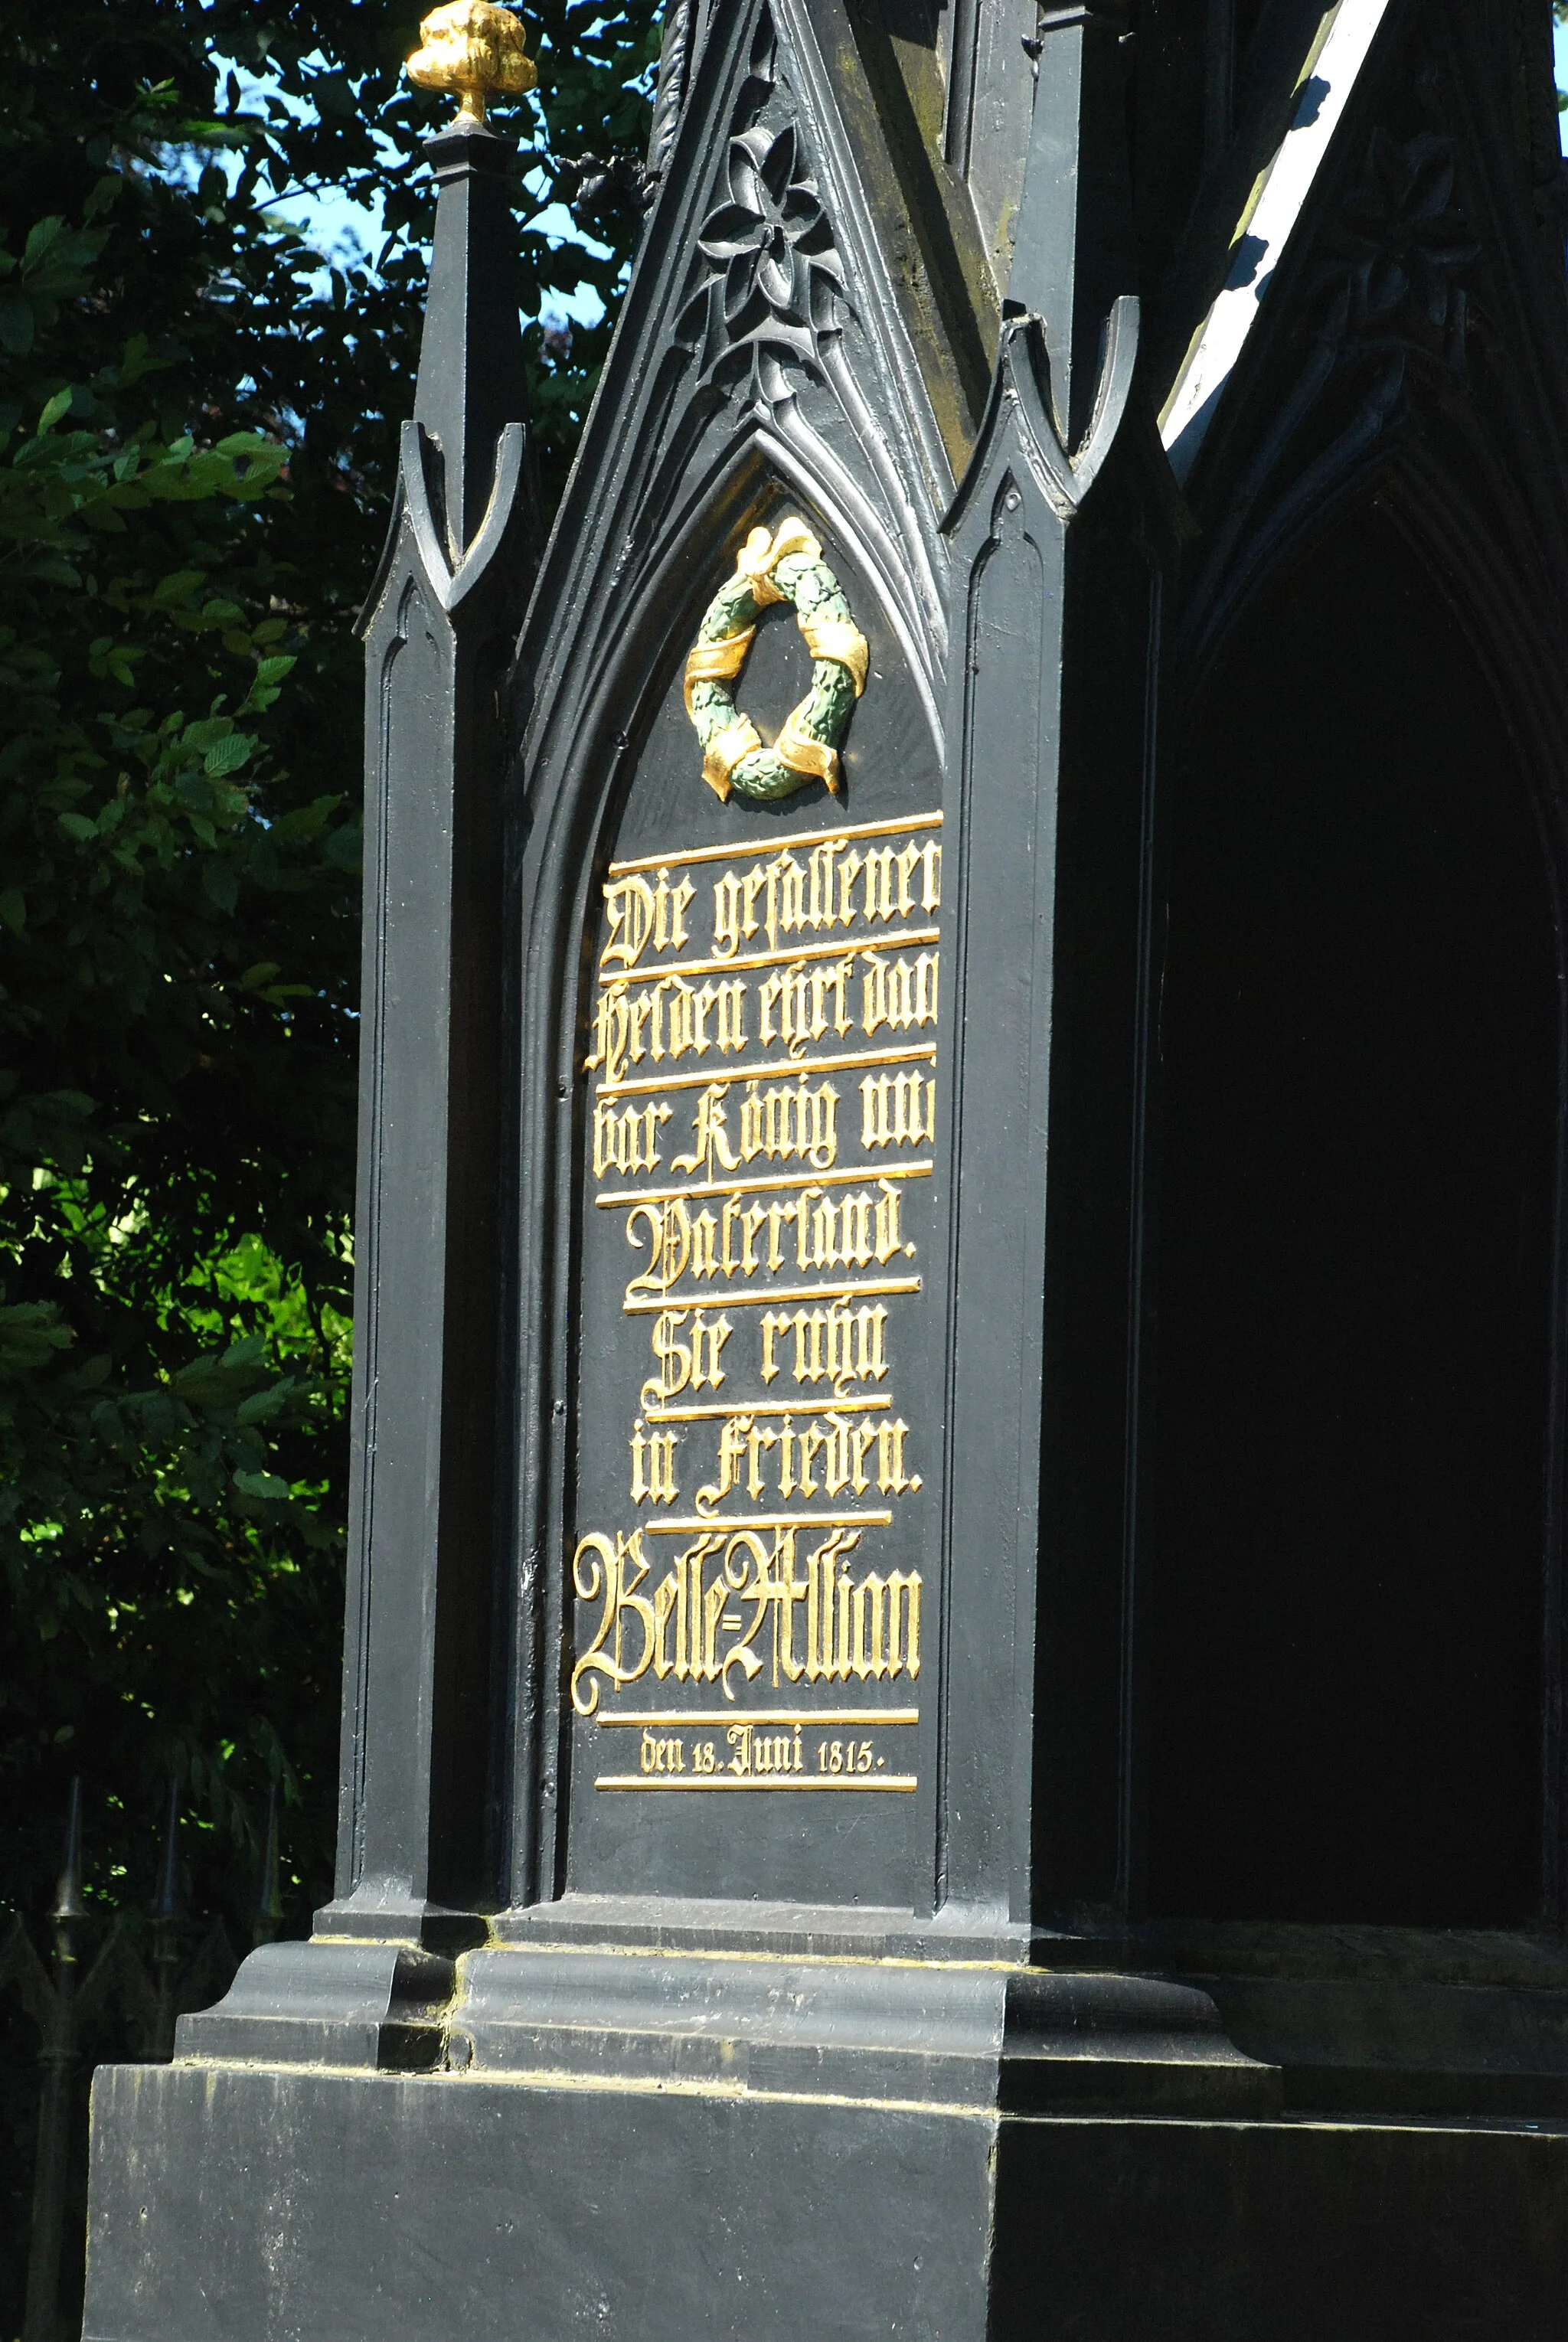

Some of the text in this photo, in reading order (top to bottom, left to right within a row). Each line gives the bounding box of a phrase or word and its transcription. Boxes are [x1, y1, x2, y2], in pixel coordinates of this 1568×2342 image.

[599, 838, 942, 968] Die gefallenen
[583, 975, 748, 1083] Helden
[758, 951, 855, 1059] ehrt
[593, 1097, 673, 1180] bar
[671, 1073, 840, 1184] König
[626, 1178, 916, 1299] Vaterland.
[640, 1295, 889, 1411] Sie ruhn
[630, 1412, 923, 1518] in Frieden.
[640, 1723, 885, 1777] den 18. Juni 1815.
